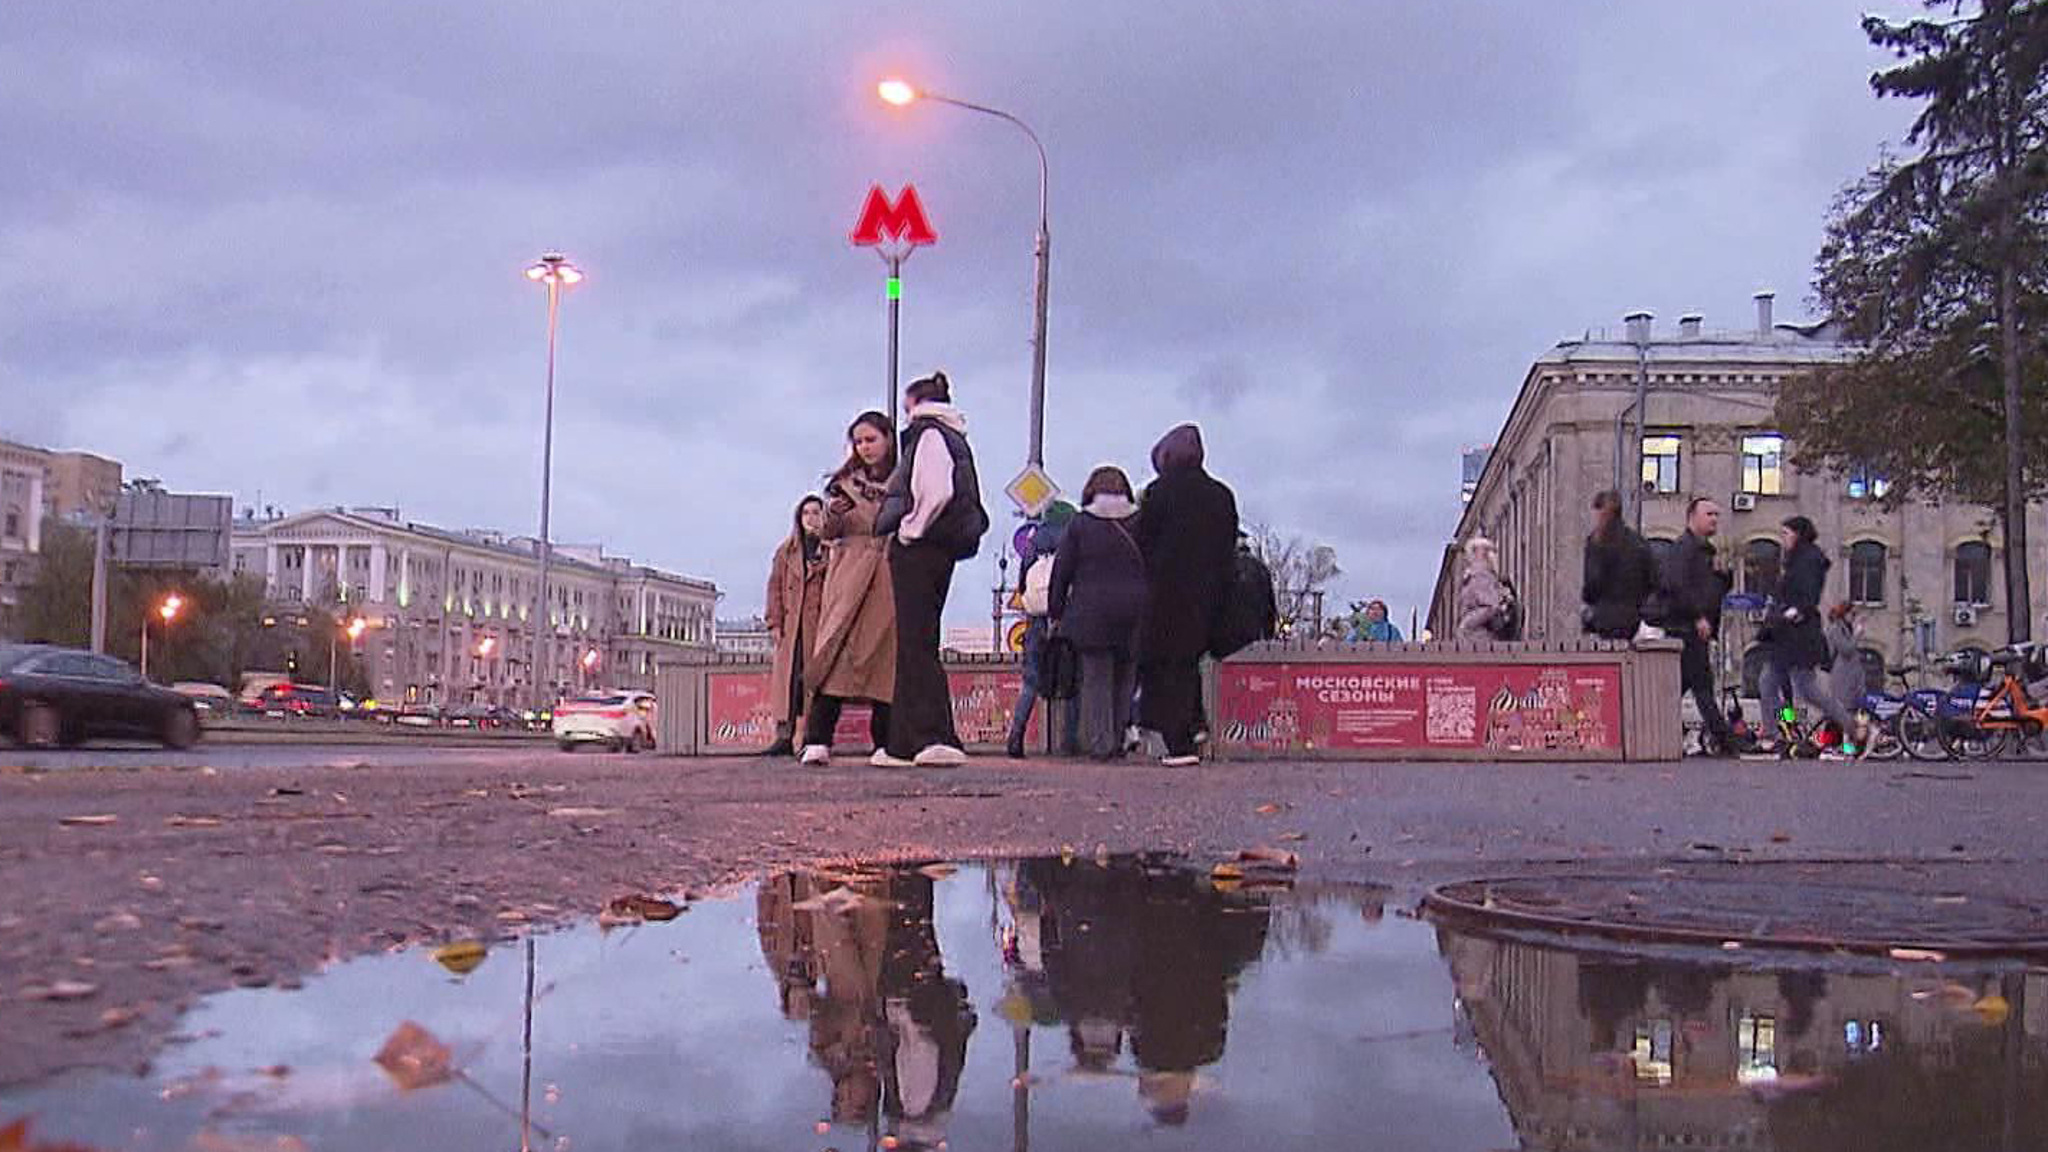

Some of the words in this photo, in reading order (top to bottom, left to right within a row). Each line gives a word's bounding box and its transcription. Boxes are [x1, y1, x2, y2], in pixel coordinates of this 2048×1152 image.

[850, 183, 938, 246] М
[1296, 677, 1420, 690] МОСКОВСКИЕ
[1318, 690, 1395, 703] СЕЗОНЫ
